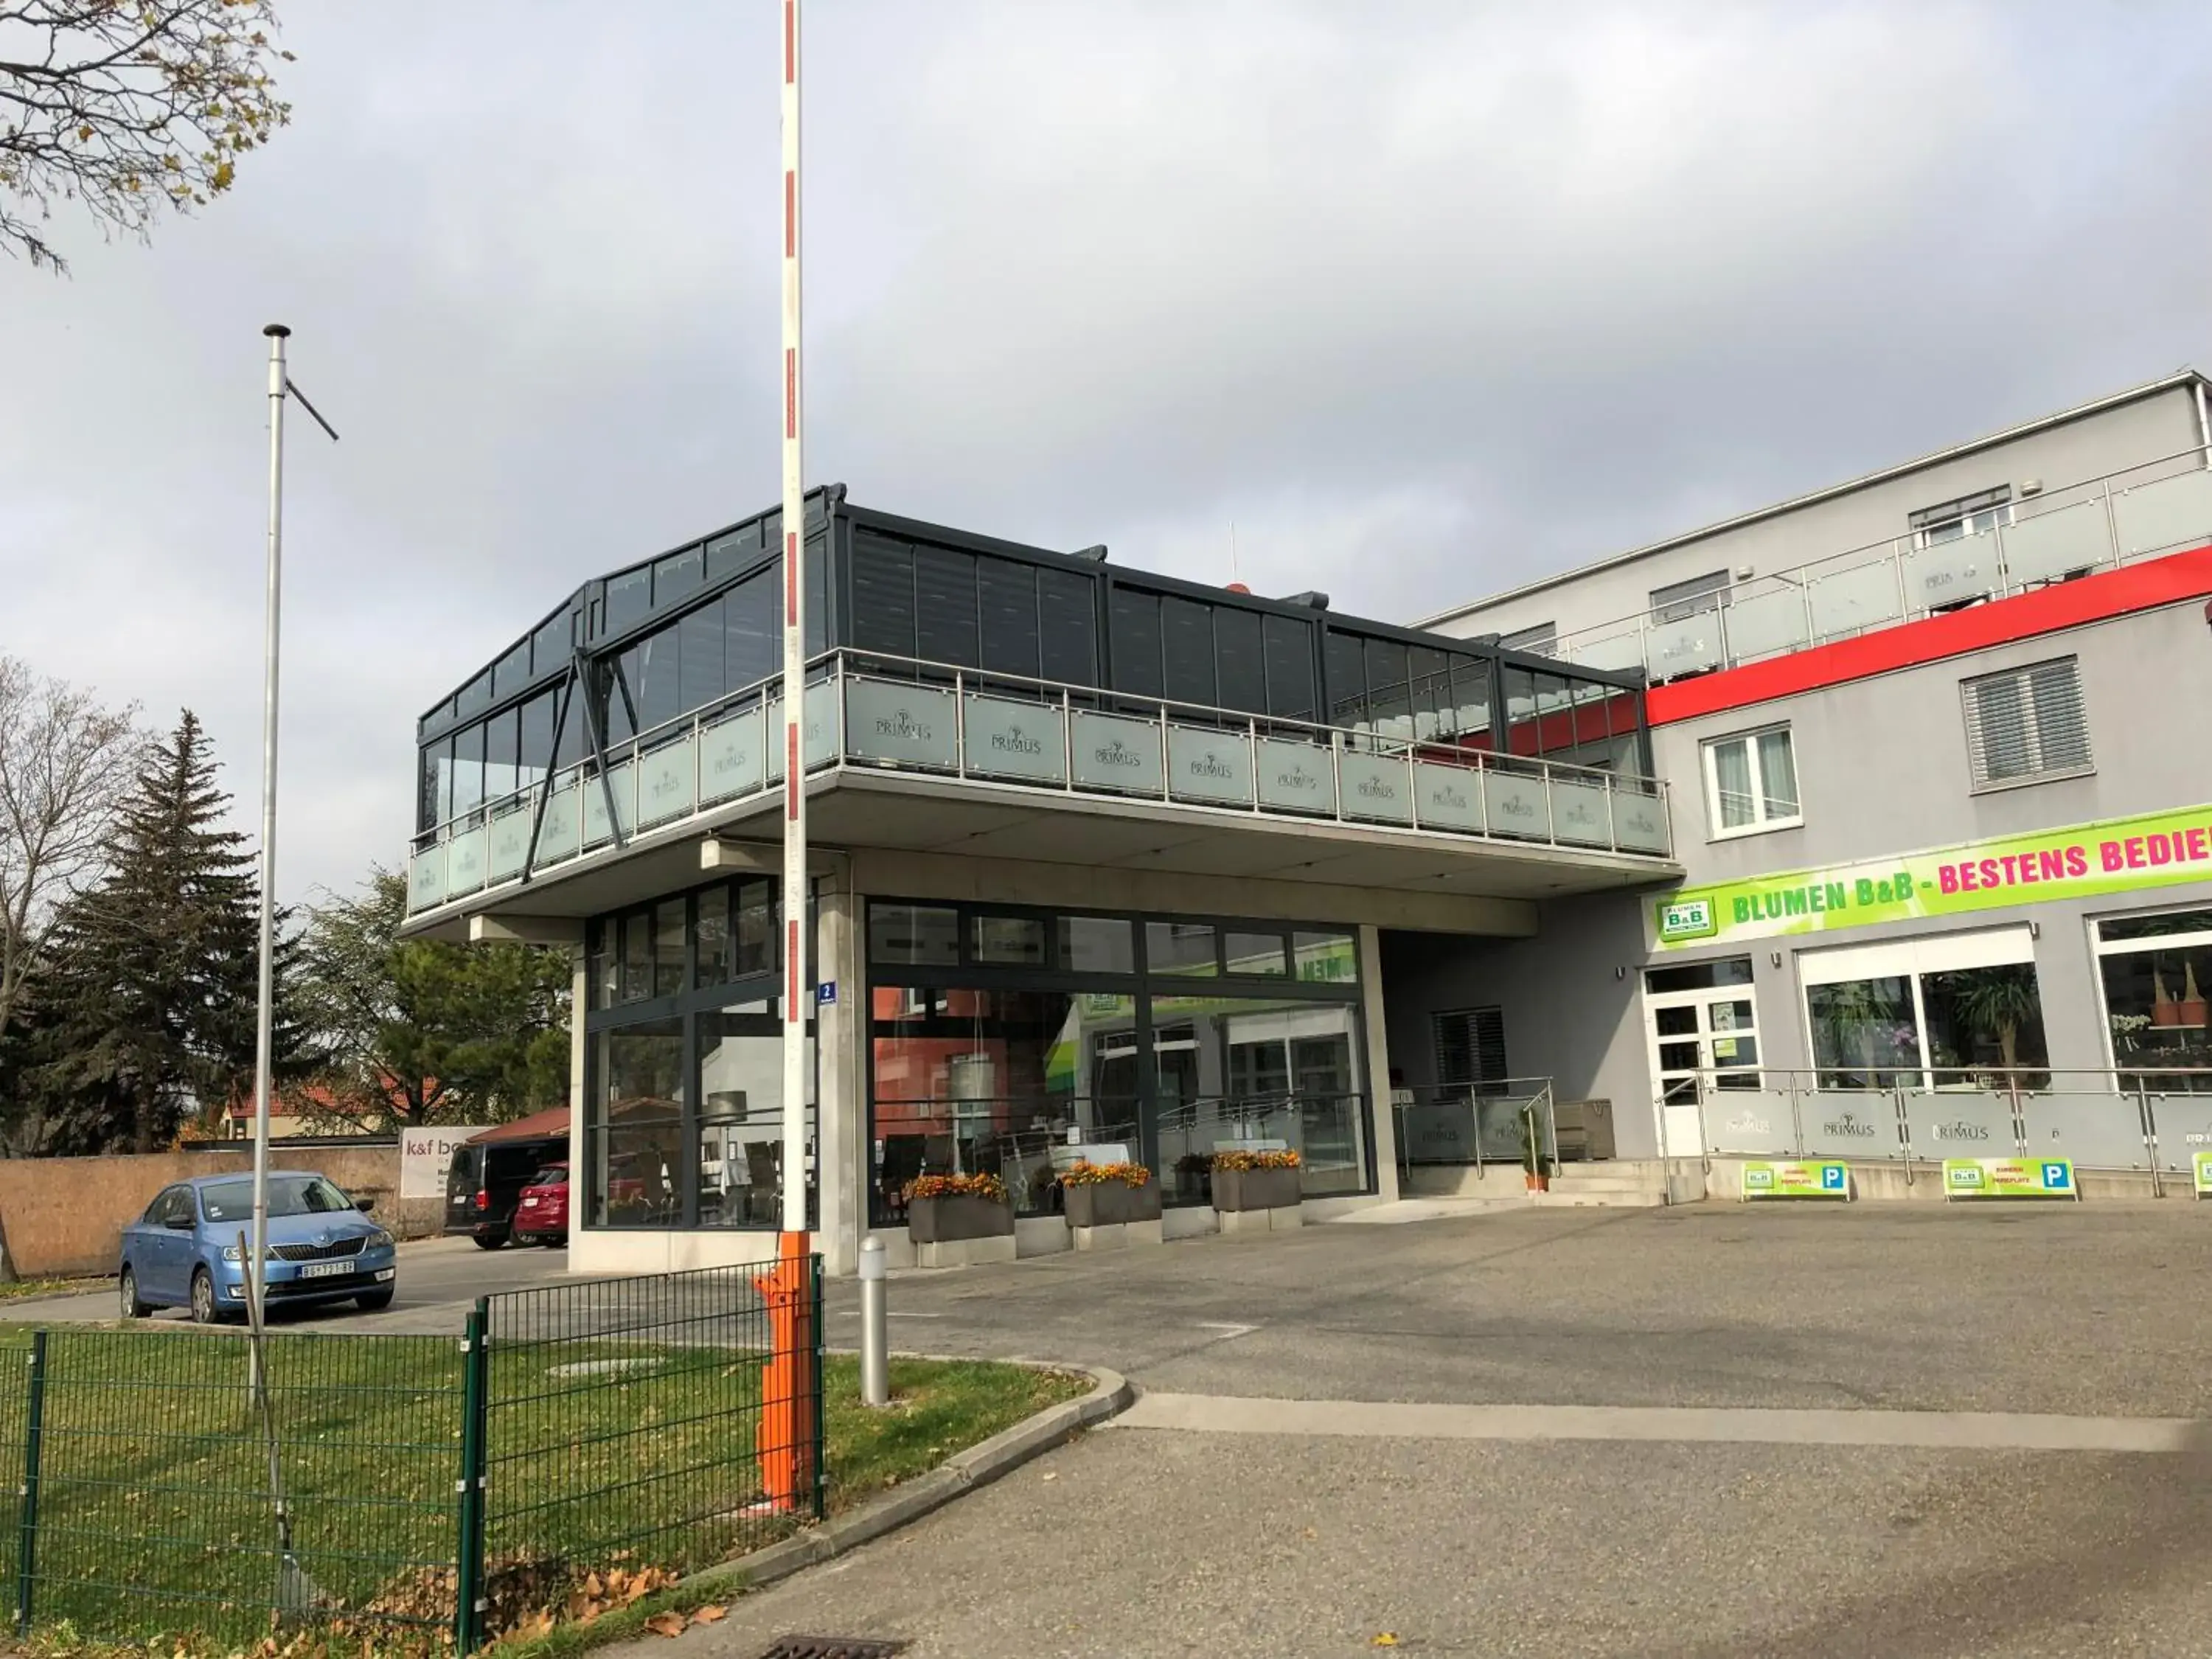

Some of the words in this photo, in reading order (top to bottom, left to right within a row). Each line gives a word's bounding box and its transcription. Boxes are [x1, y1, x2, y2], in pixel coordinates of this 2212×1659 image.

[992, 734, 1041, 754] PRIMUS
[1096, 748, 1141, 767] PRIMUS
[1191, 761, 1233, 778] PRIMUS
[1733, 882, 1846, 923] BLUMEN
[1855, 872, 1913, 907] B&B
[1938, 846, 2088, 894] BESTENS
[2099, 827, 2212, 872] BEDIE
[824, 984, 830, 997] 2
[1823, 1121, 1876, 1138] PRIMUS
[406, 1139, 434, 1155] k&f
[1826, 1169, 1840, 1186] P
[2046, 1165, 2062, 1186] P
